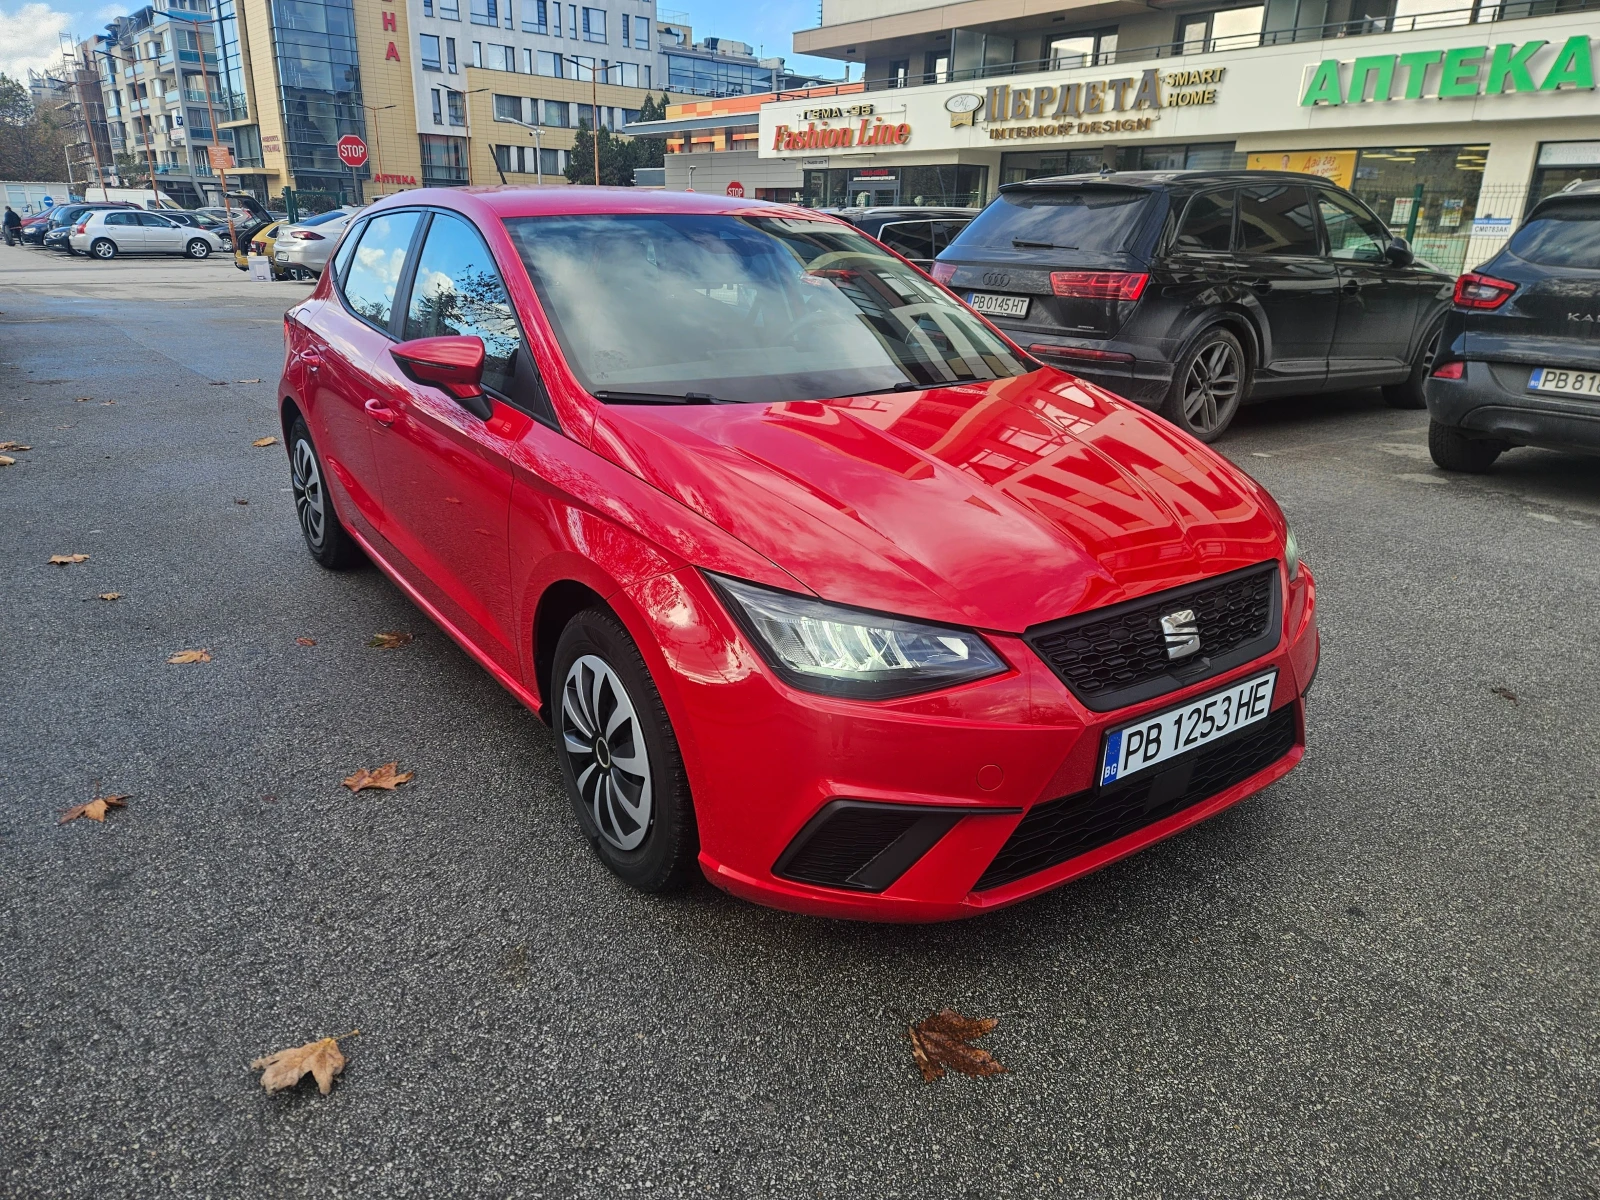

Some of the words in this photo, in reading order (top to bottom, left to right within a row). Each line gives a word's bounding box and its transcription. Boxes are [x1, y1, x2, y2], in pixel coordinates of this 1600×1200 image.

[1165, 67, 1226, 87] SMART
[1301, 35, 1595, 107] АПТЕКА
[984, 68, 1162, 122] ПЕРДЕТА
[1166, 89, 1216, 107] HOME
[772, 124, 854, 151] Fashion
[856, 116, 912, 147] Line
[989, 122, 1072, 140] INTERIOR
[1077, 117, 1151, 134] DESIGN
[341, 144, 365, 158] STOP
[374, 173, 417, 186] АПТЕКА
[728, 187, 743, 198] STOP
[1567, 312, 1600, 322] KA
[1542, 371, 1569, 389] PB
[1123, 722, 1162, 771] PB
[1173, 695, 1232, 751] 1253
[1233, 679, 1270, 726] HE
[1104, 763, 1118, 778] BG
